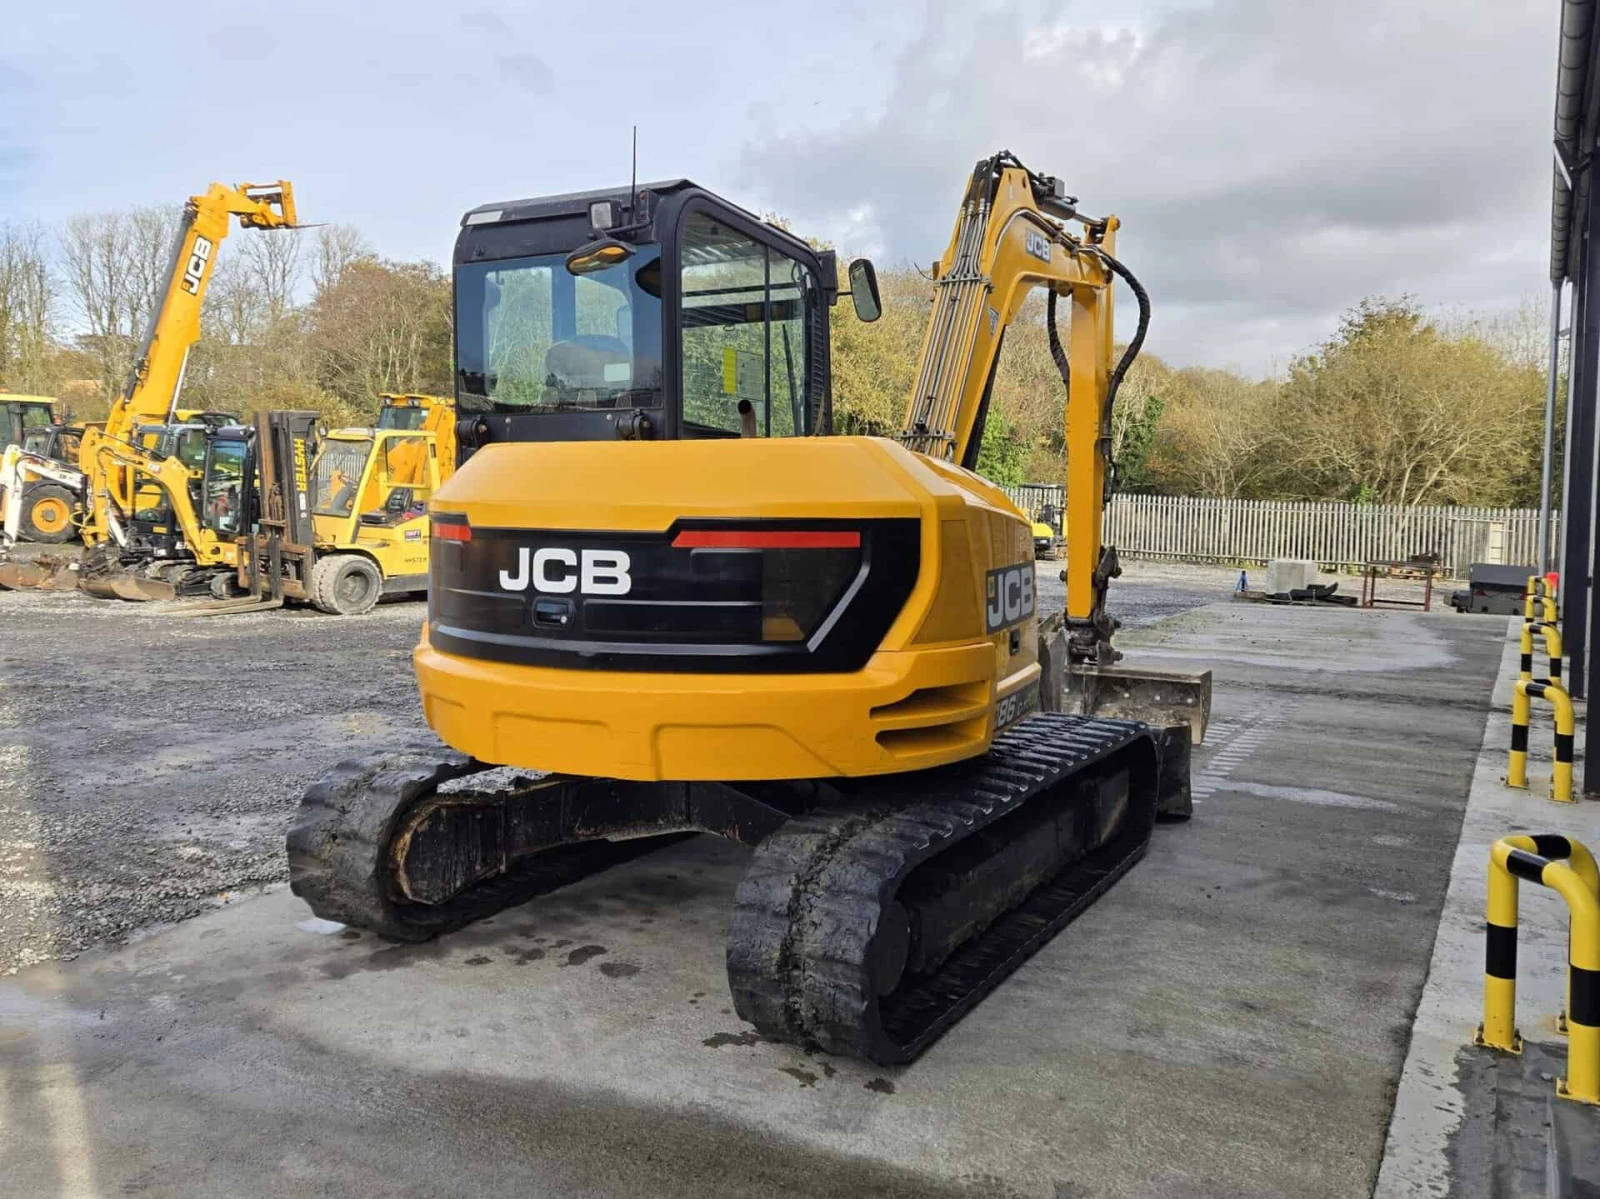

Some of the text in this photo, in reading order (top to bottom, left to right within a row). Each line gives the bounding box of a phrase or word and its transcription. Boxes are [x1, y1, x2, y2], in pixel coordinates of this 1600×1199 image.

[184, 236, 212, 294] JCB
[1027, 232, 1051, 260] JCB
[293, 438, 308, 492] HYSTER
[499, 547, 632, 595] JCB
[988, 566, 1034, 628] JCB
[998, 694, 1017, 727] 86
